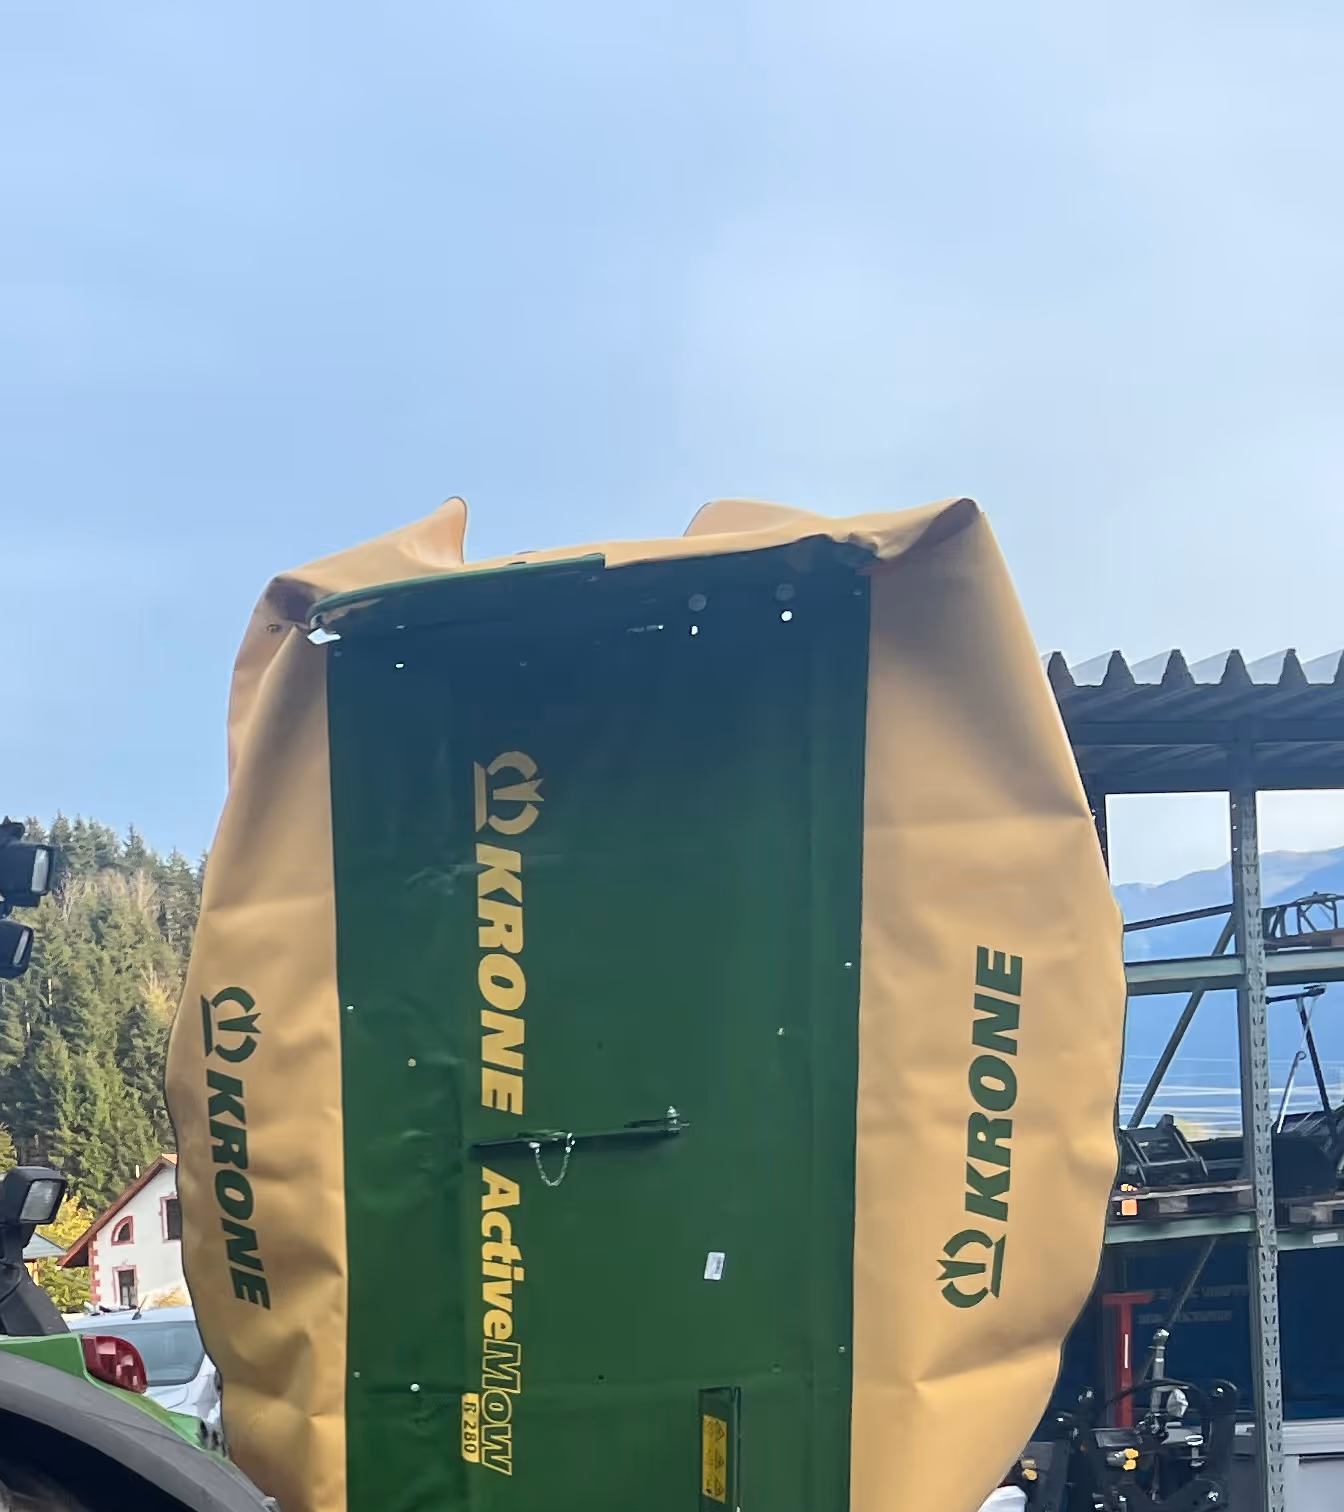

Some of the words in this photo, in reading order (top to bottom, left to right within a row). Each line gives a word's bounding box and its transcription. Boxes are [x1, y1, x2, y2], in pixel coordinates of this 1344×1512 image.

[476, 842, 527, 1115] KRONE
[964, 944, 1023, 1222] KRONE
[206, 1068, 271, 1310] KRONE
[463, 1402, 477, 1413] R
[463, 1419, 477, 1454] 280
